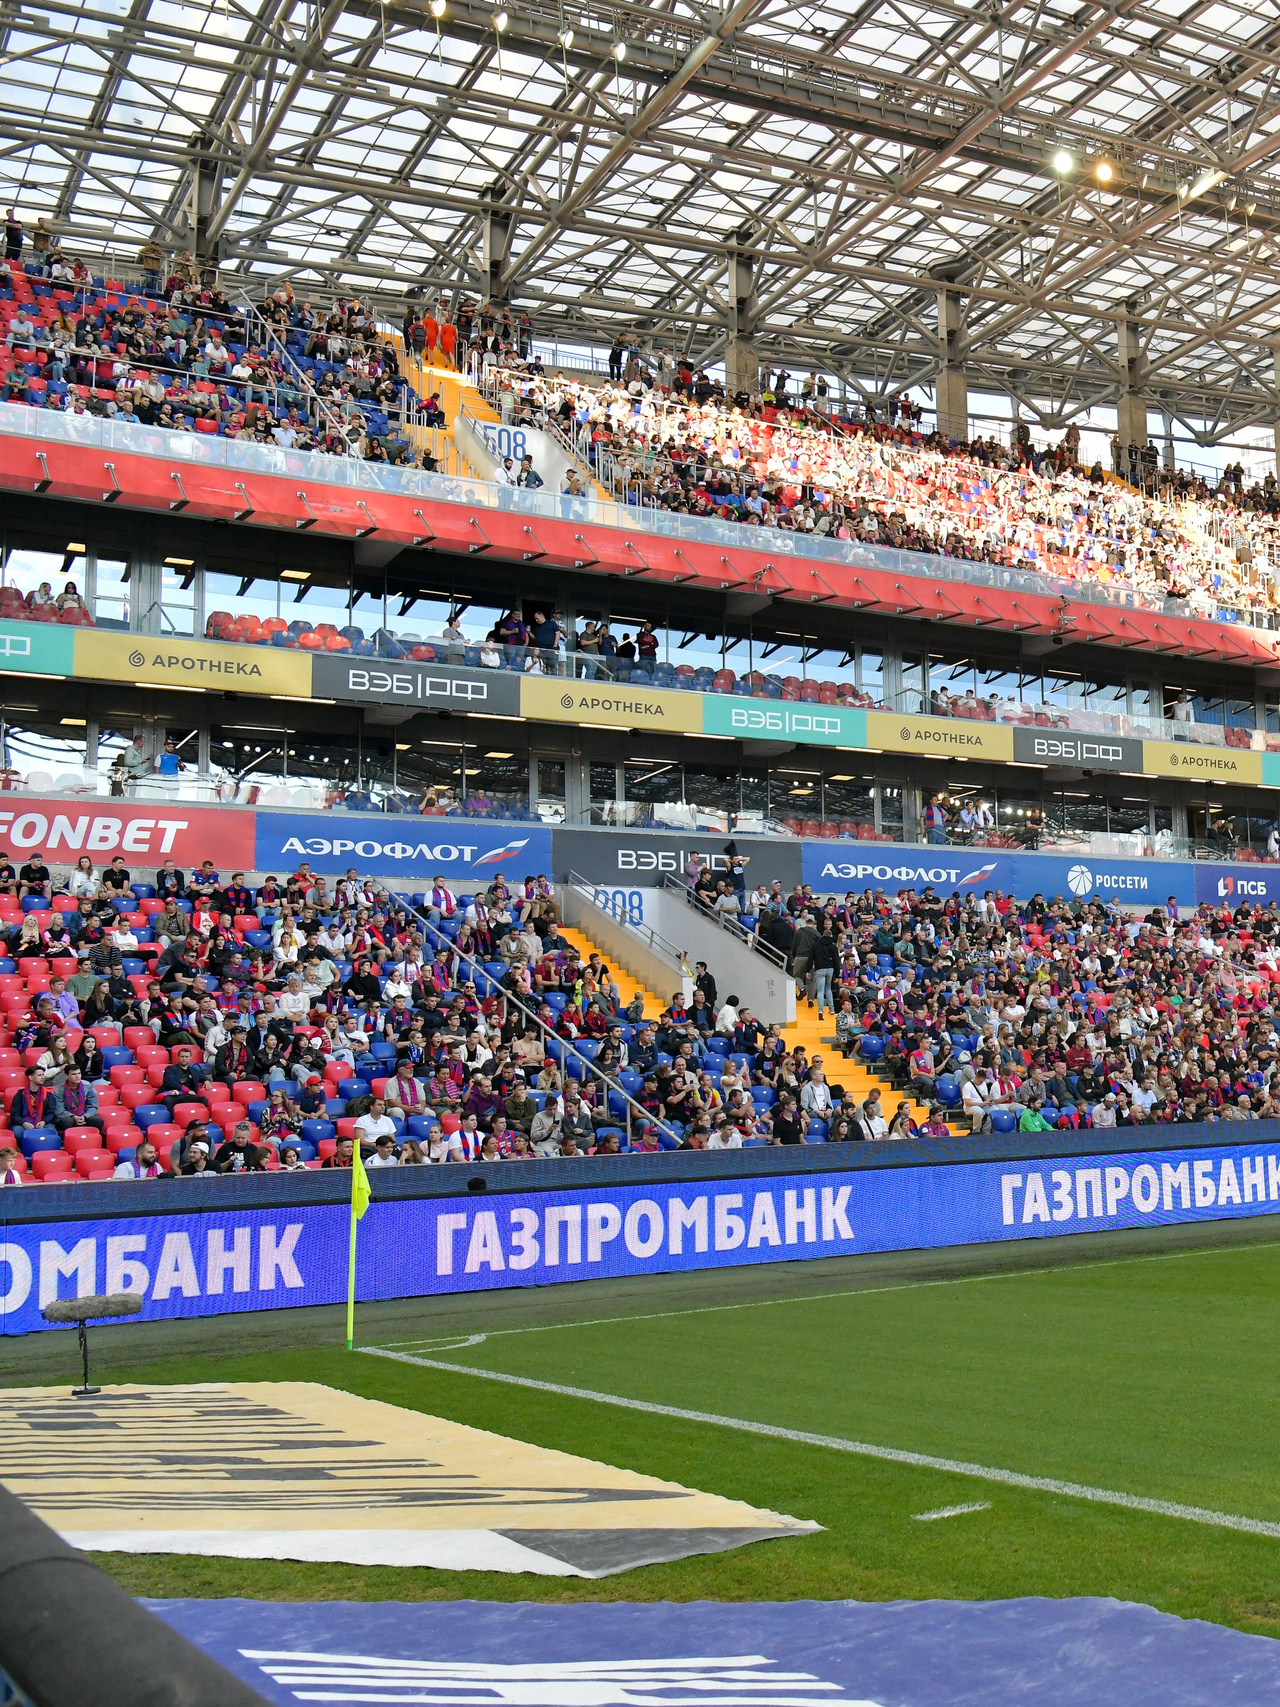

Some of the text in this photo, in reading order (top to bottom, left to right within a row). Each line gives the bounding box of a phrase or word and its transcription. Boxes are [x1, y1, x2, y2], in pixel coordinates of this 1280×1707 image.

[483, 425, 526, 461] 508
[152, 651, 262, 676] APOTHEKA
[578, 695, 665, 716] APOTHEKA
[914, 729, 983, 747] APOTHEKA
[1181, 754, 1238, 770] APOTHEKA
[0, 811, 189, 854] FONBET
[280, 837, 478, 863] АЭРОФЛОТ
[821, 861, 961, 882] АЭРОФЛОТ
[1095, 875, 1148, 891] РОССЕТИ
[1237, 880, 1267, 896] ПСБ
[436, 1185, 855, 1276] ГАЗПРОМБАНК
